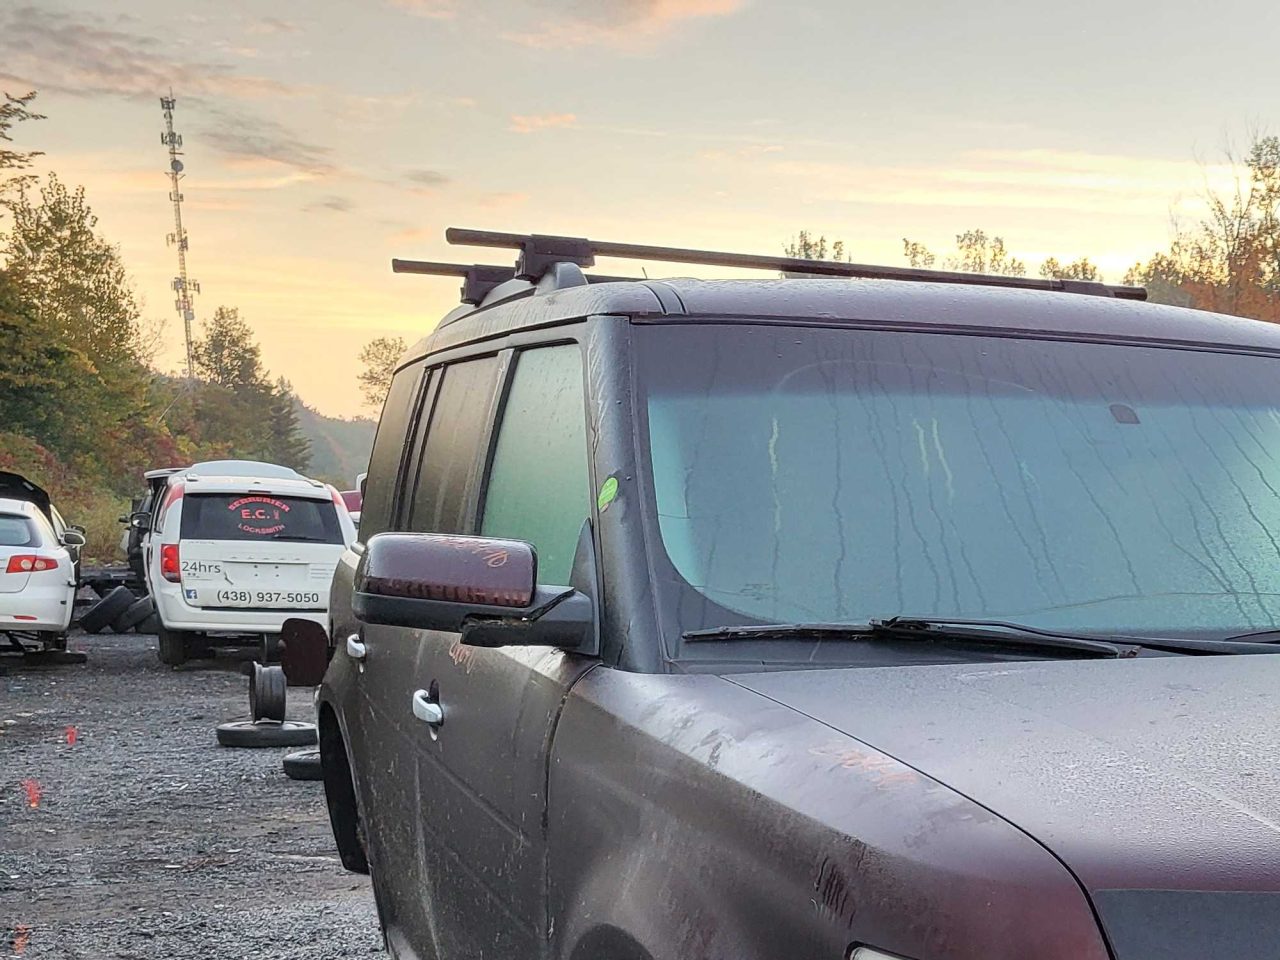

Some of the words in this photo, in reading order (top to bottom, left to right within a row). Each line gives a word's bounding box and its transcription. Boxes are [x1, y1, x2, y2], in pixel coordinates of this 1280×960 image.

[241, 509, 270, 519] E.C.
[182, 561, 221, 573] 24hrs
[217, 590, 252, 604] (438)
[256, 592, 319, 603] 937-5050
